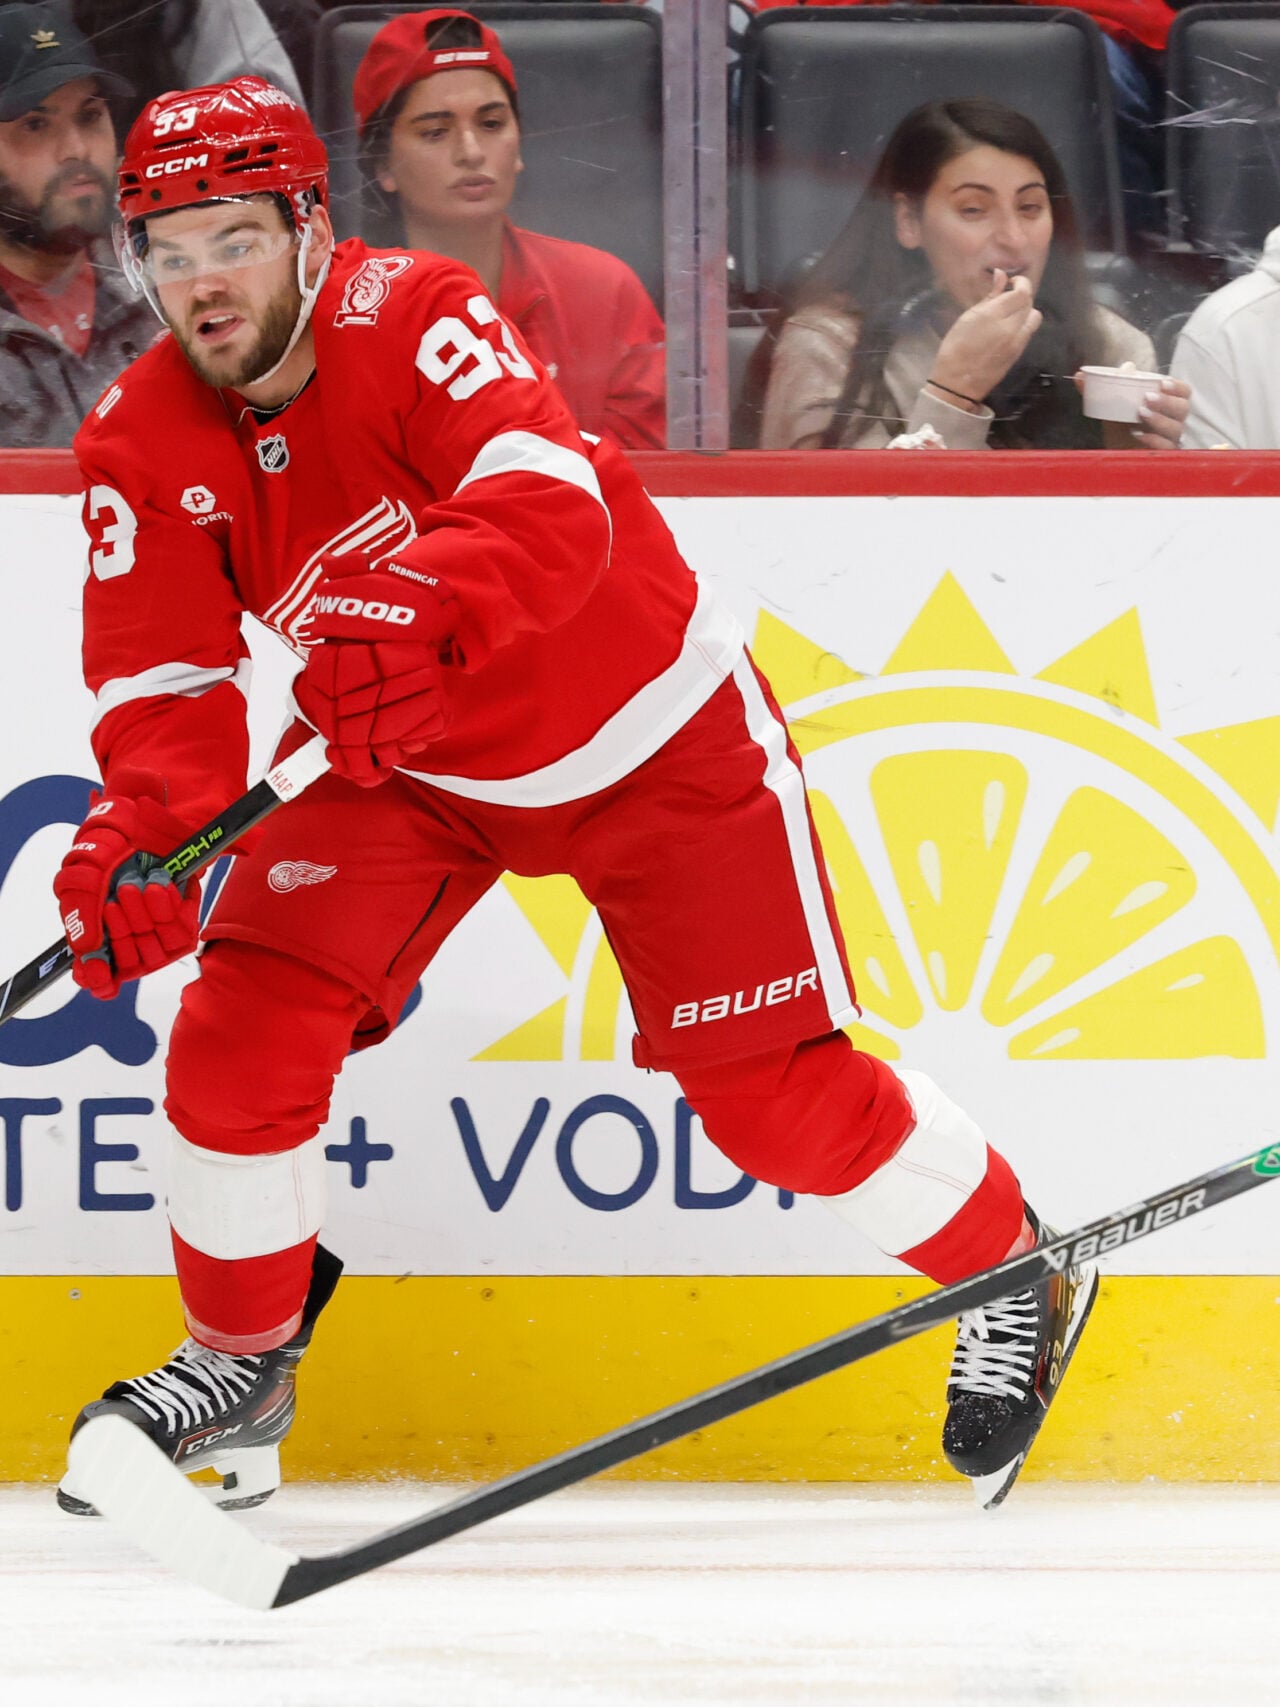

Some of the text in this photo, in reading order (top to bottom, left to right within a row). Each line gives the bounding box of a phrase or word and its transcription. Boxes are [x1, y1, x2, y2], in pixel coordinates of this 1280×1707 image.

[152, 106, 199, 138] 93
[145, 153, 209, 179] CCM
[82, 484, 139, 582] 3
[387, 562, 439, 587] DEBRINCAT
[315, 594, 416, 626] WOOD
[670, 966, 818, 1029] BAUER
[450, 1094, 795, 1212] VOD
[1071, 1188, 1207, 1266] BAUER
[185, 1423, 244, 1455] CCM
